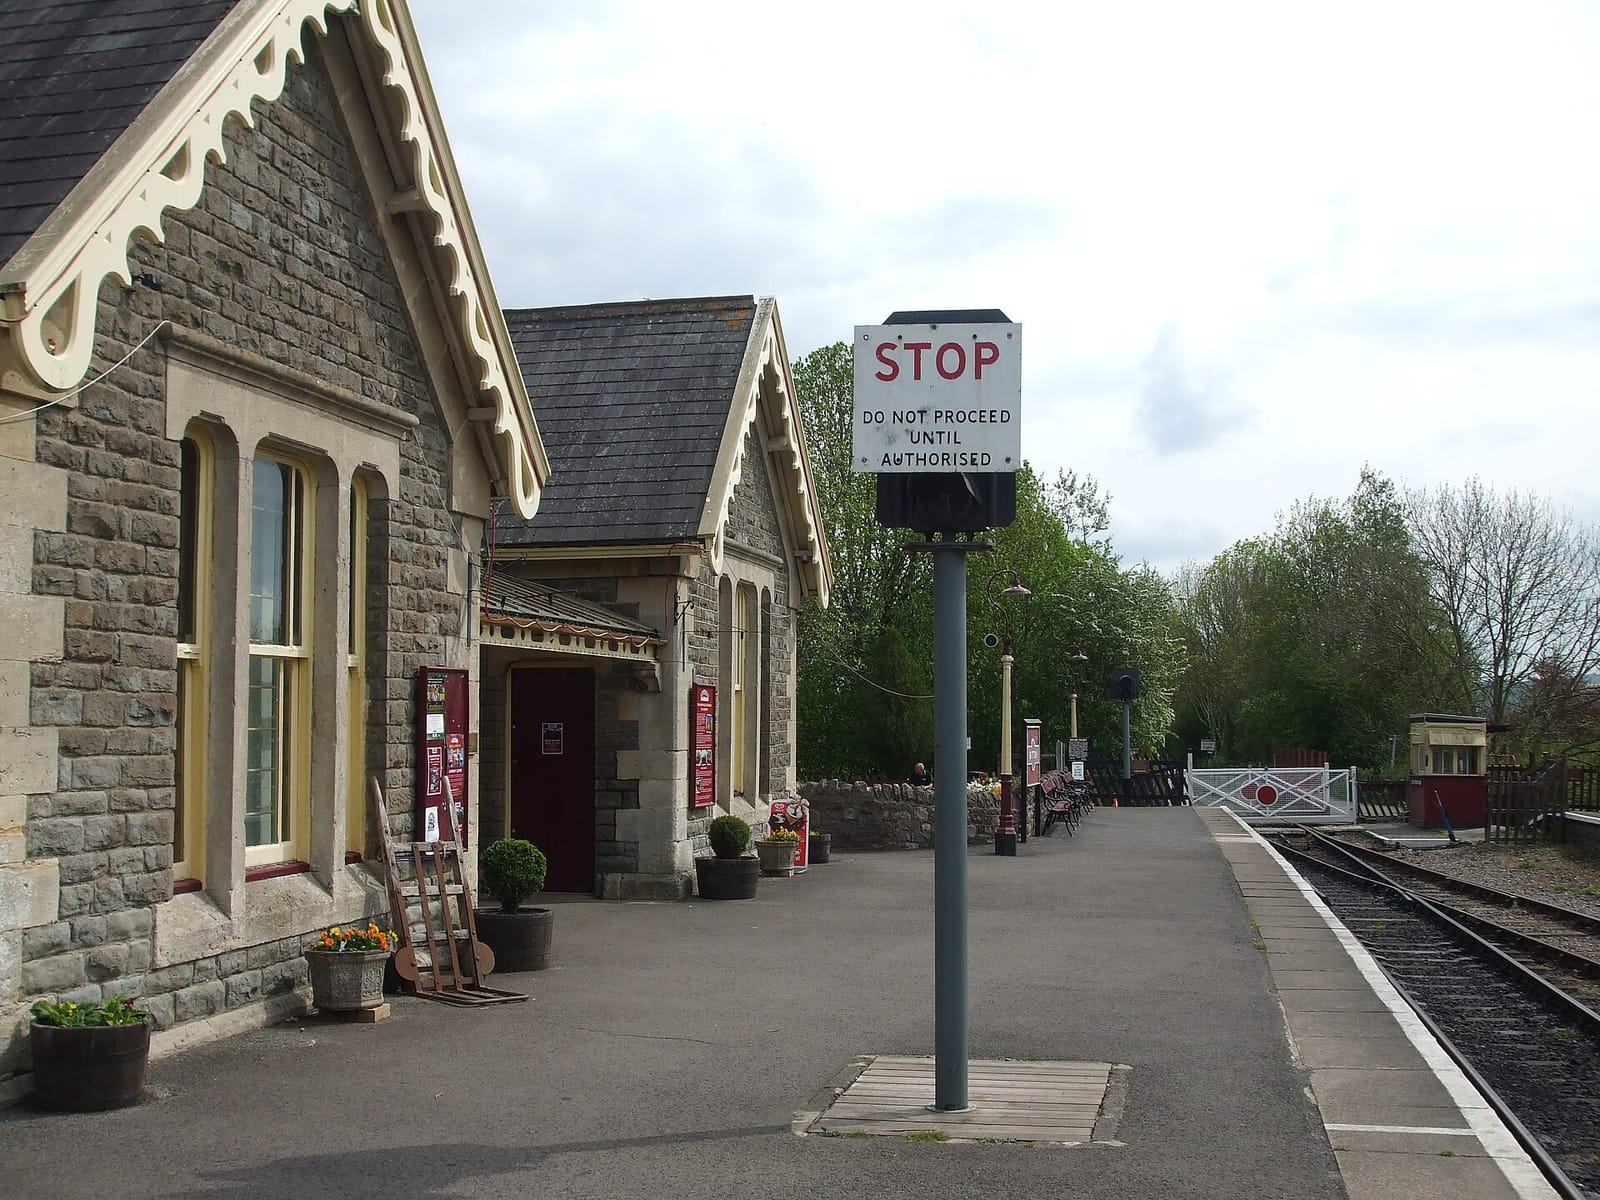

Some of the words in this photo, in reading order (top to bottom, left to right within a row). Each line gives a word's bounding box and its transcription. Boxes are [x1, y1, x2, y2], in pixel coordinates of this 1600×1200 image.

[874, 341, 1000, 382] STOP
[863, 410, 885, 424] DO
[892, 410, 927, 424] NOT
[934, 409, 1011, 424] PROCEED
[909, 430, 962, 445] UNTIL
[881, 452, 992, 467] AUTHORISED
